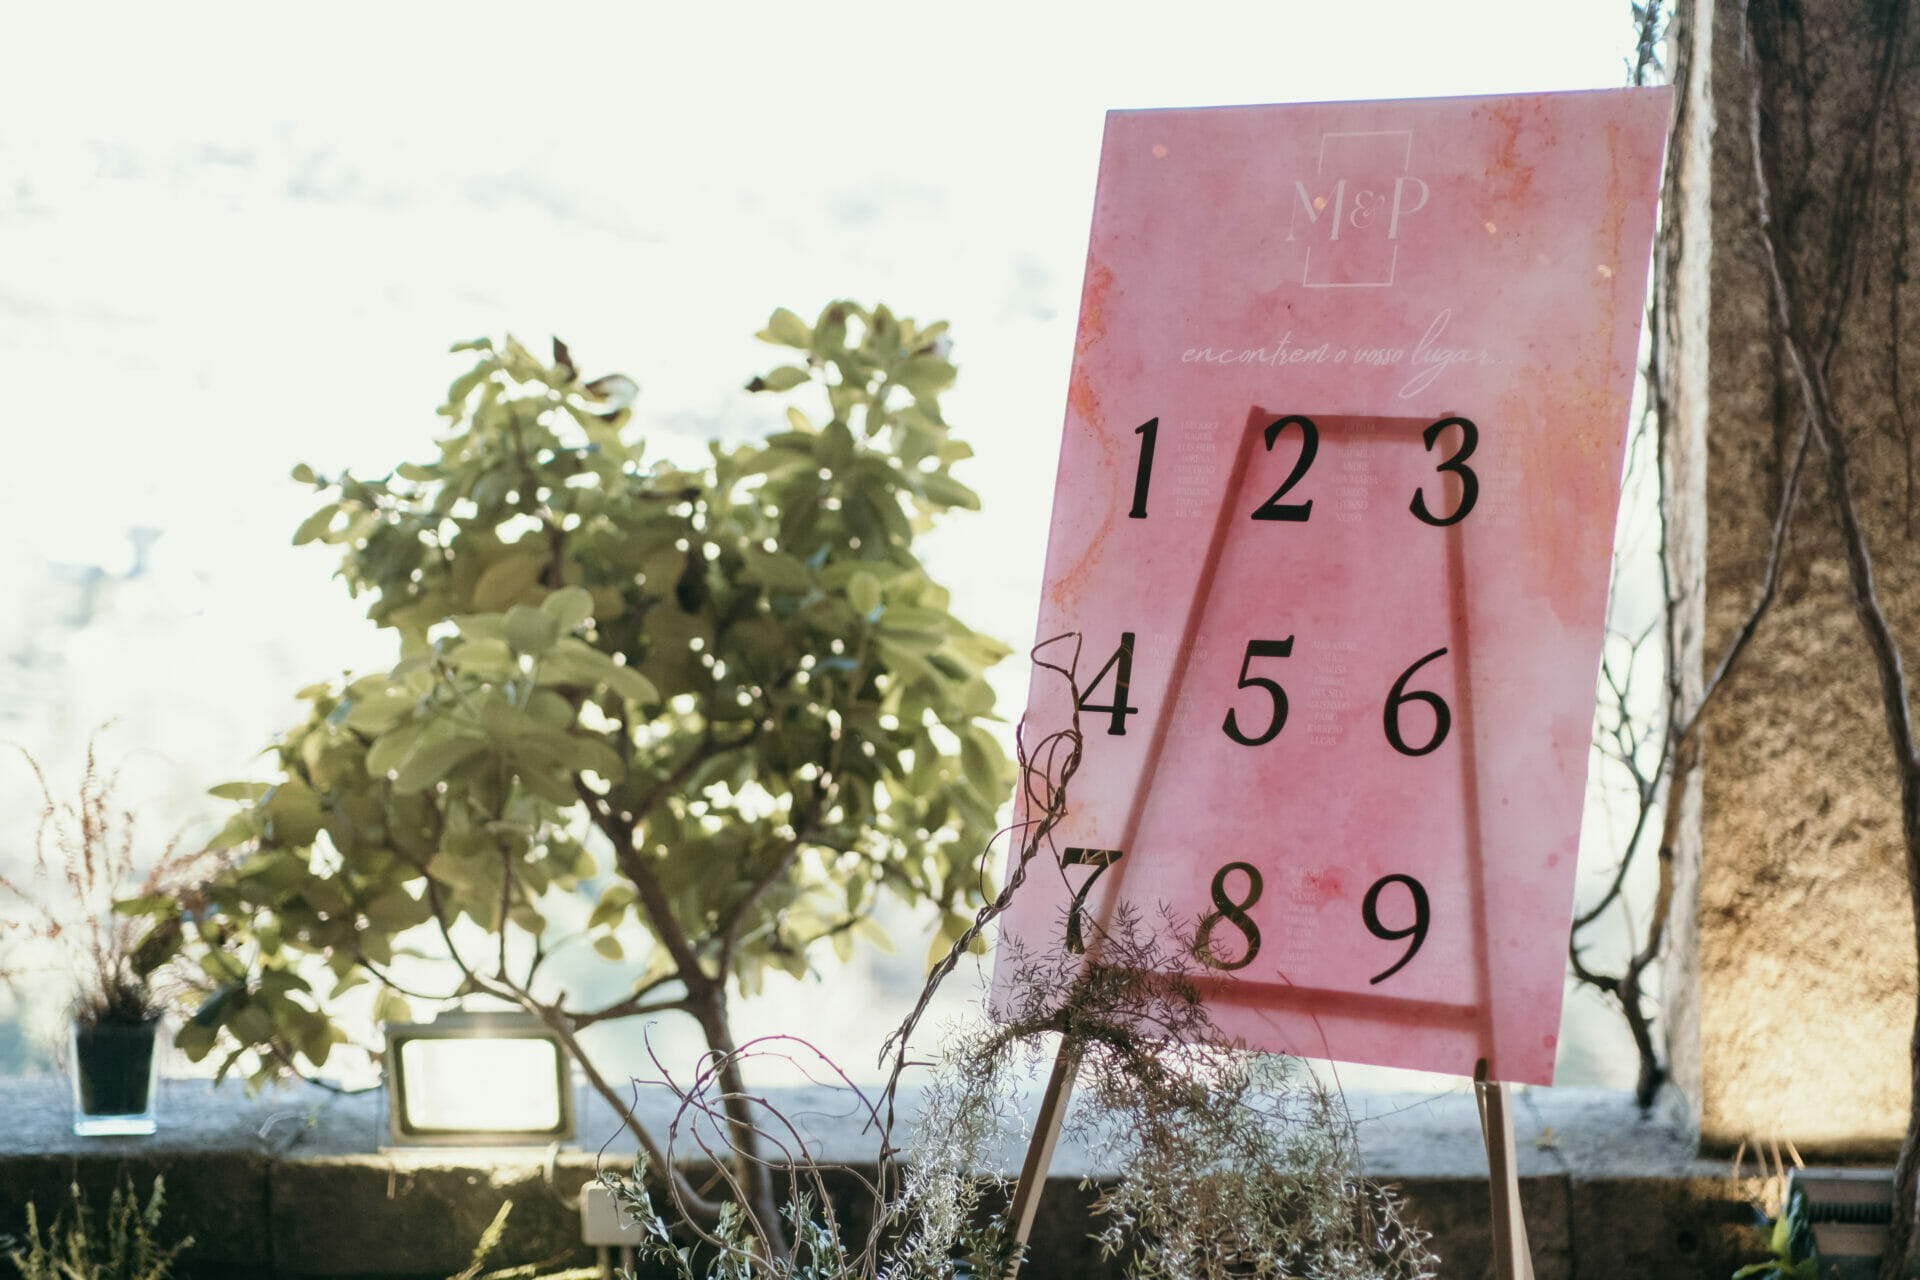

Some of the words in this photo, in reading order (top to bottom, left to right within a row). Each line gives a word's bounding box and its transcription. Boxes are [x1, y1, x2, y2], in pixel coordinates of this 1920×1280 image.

[1182, 331, 1330, 367] encontrem
[1334, 349, 1346, 363] o
[1353, 347, 1401, 366] vosso
[1128, 417, 1159, 519] 1
[1250, 415, 1319, 522] 2
[1410, 417, 1479, 527] 3
[1078, 632, 1139, 736] 4
[1222, 635, 1295, 747] 5
[1384, 647, 1451, 757] 6
[1062, 847, 1124, 955] 7
[1194, 861, 1264, 971] 8
[1362, 873, 1431, 986] 9
